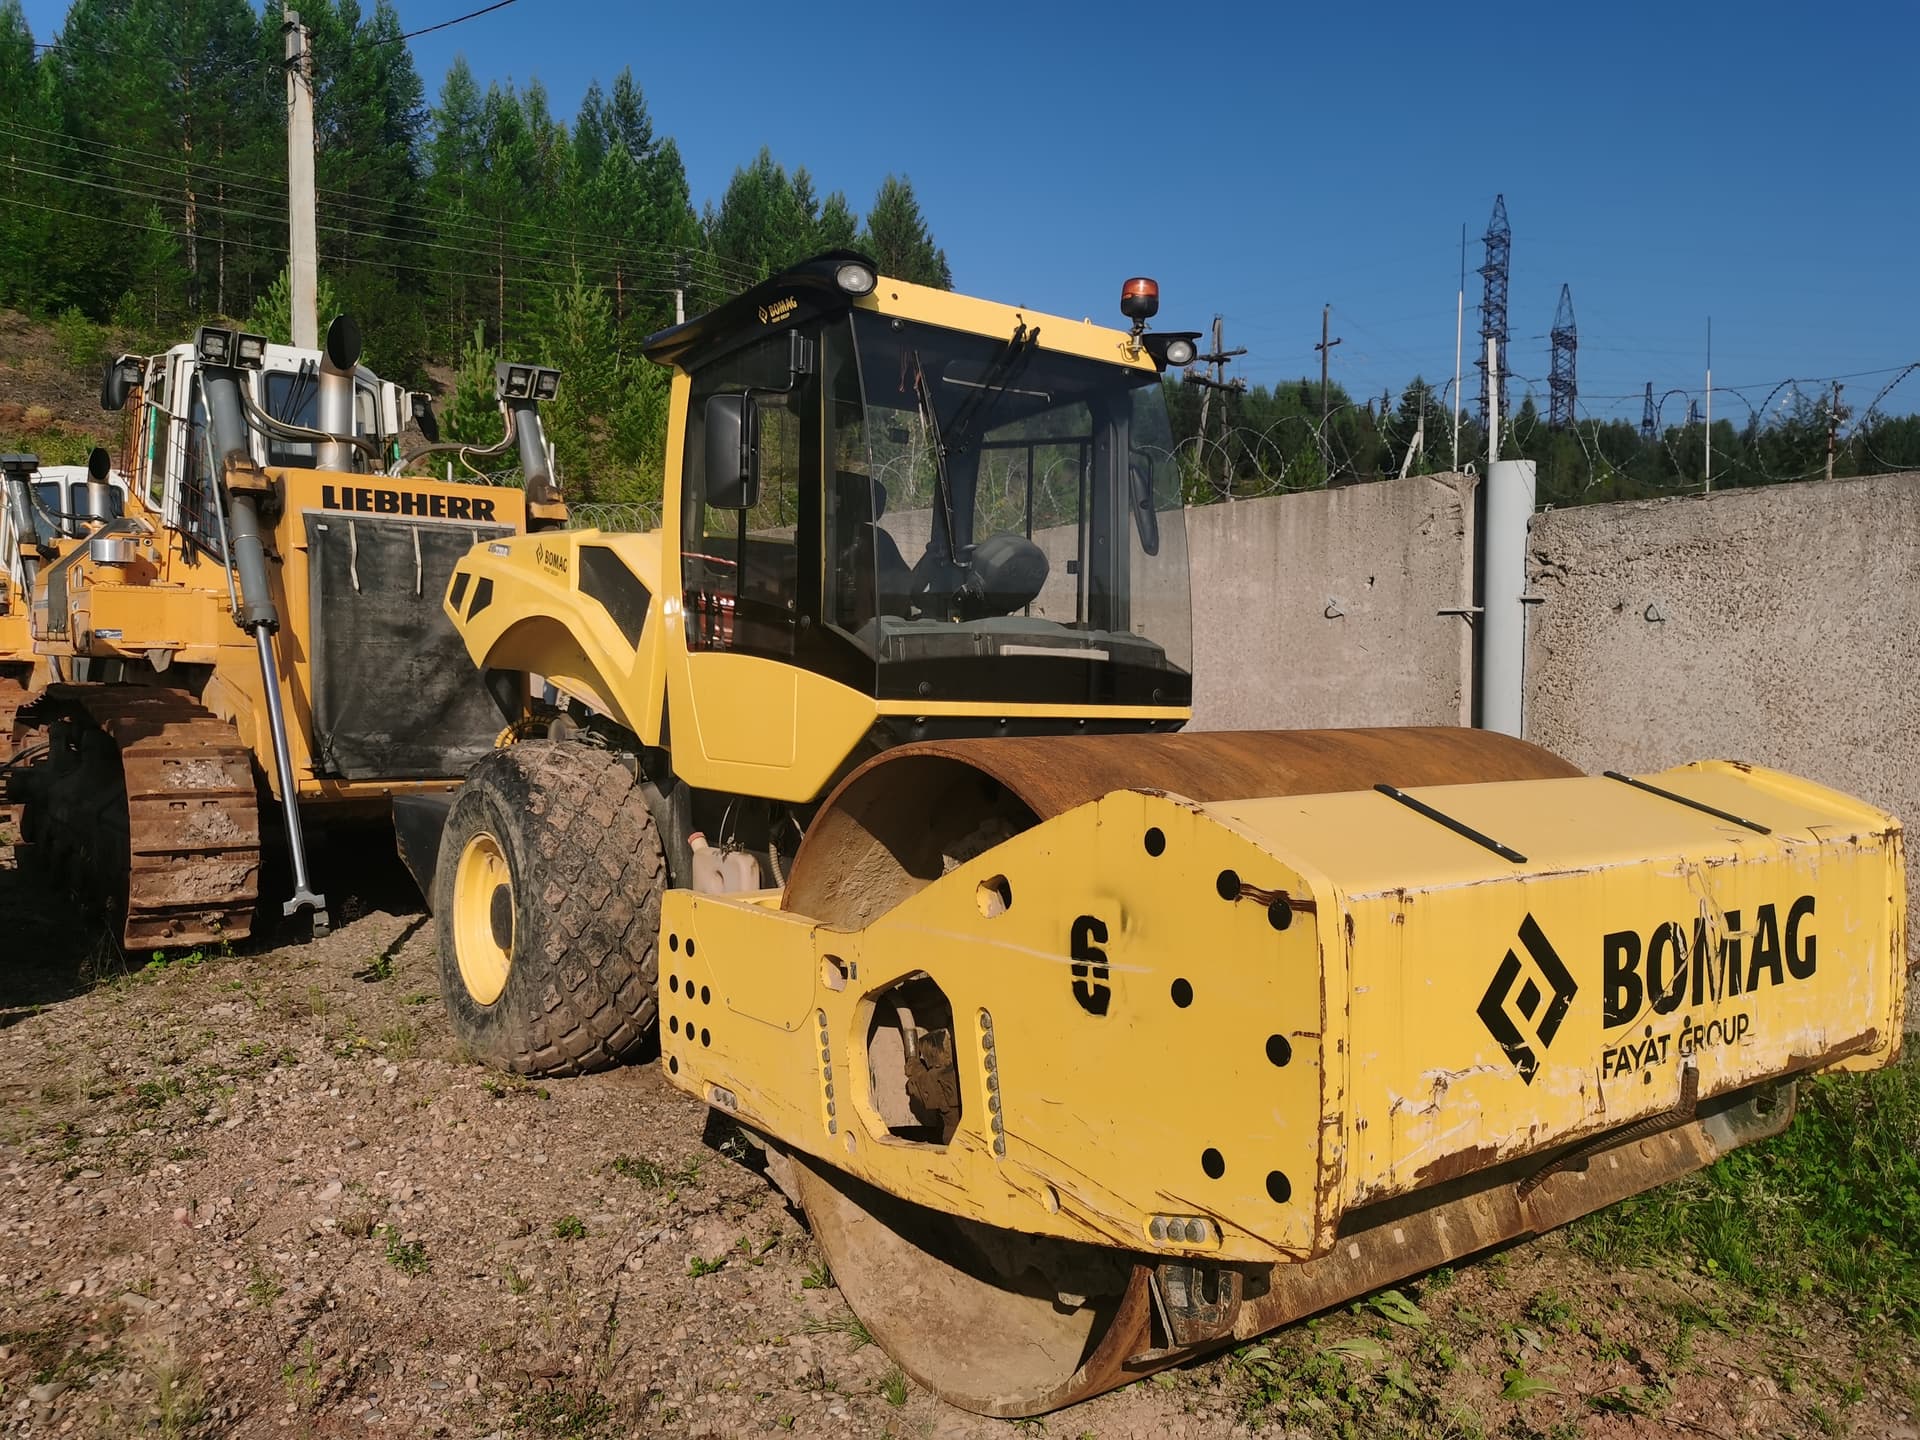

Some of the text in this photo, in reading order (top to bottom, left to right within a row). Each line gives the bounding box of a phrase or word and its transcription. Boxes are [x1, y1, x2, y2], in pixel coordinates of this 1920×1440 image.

[768, 296, 798, 317] BOMAG
[322, 485, 496, 521] LIEBHERR
[544, 550, 567, 573] BOMAG
[1603, 895, 1816, 1029] BOMAG
[1603, 1013, 1749, 1079] FAYAT GROUP
